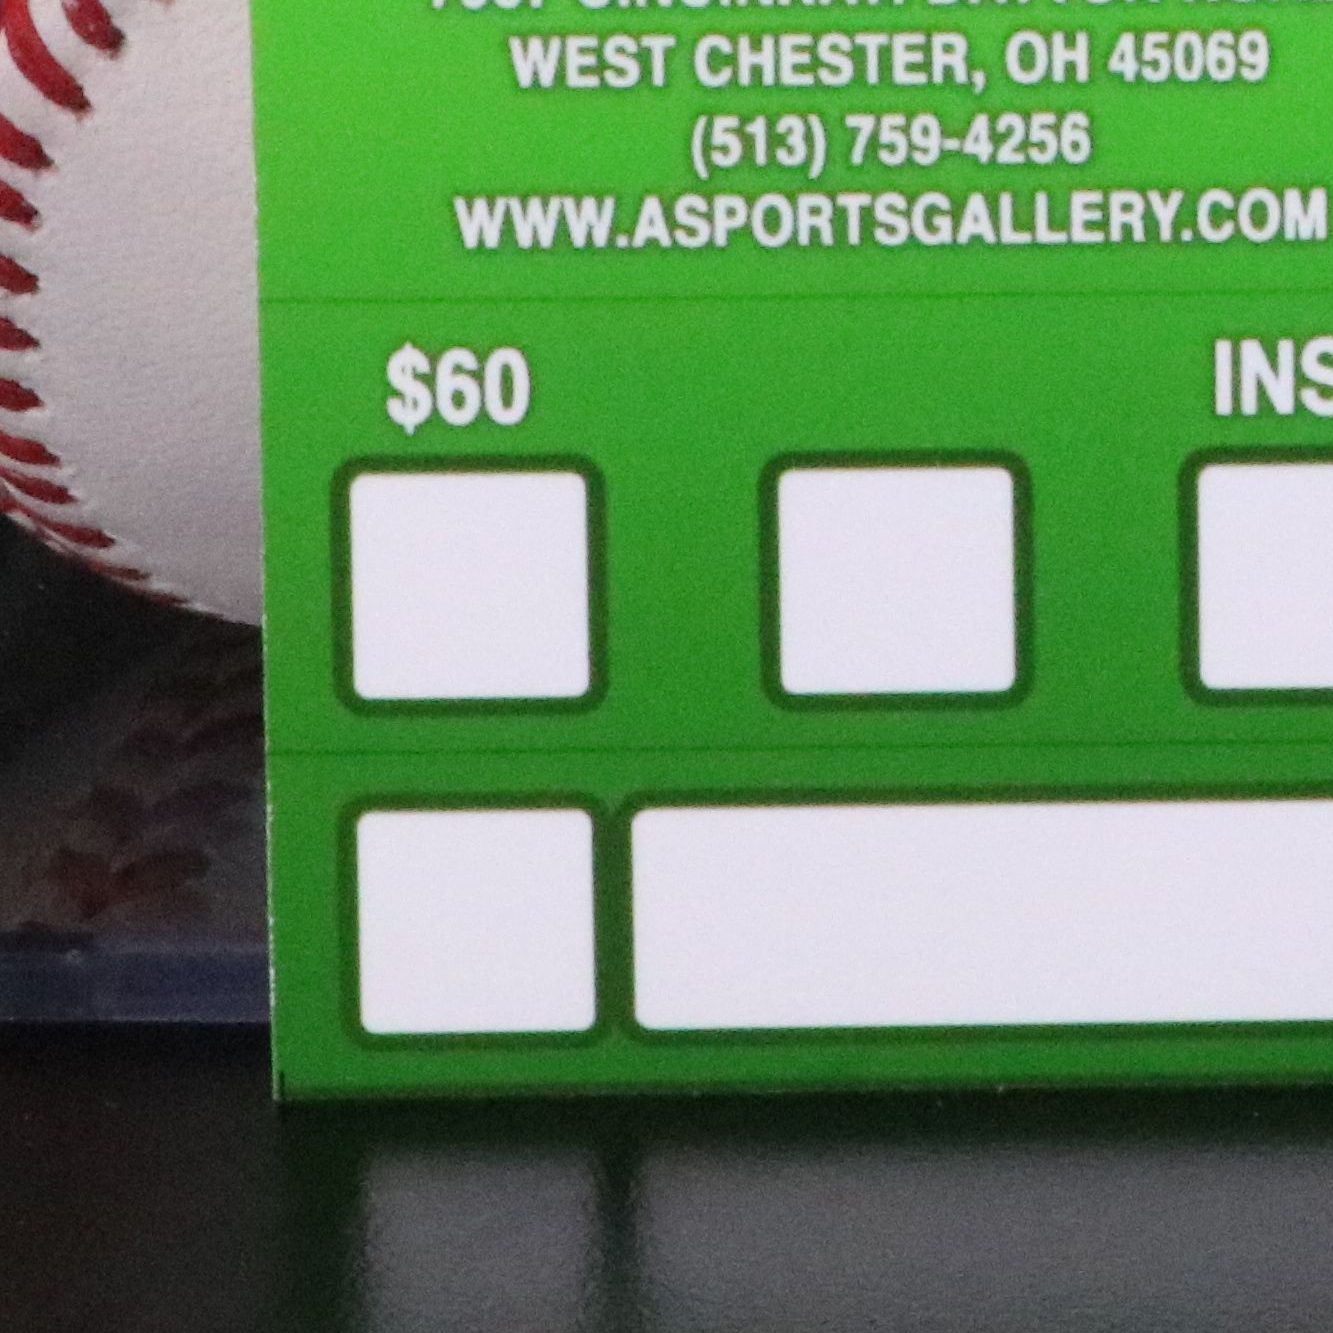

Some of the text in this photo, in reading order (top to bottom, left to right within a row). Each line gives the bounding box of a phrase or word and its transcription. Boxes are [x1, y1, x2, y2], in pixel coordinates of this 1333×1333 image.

[509, 29, 1271, 95] WEST CHESTER, OH 45069
[691, 111, 1093, 180] (513) 759-4256
[453, 187, 1329, 250] WWW.ASPORTSGALLERY.COM
[384, 342, 532, 435] $60
